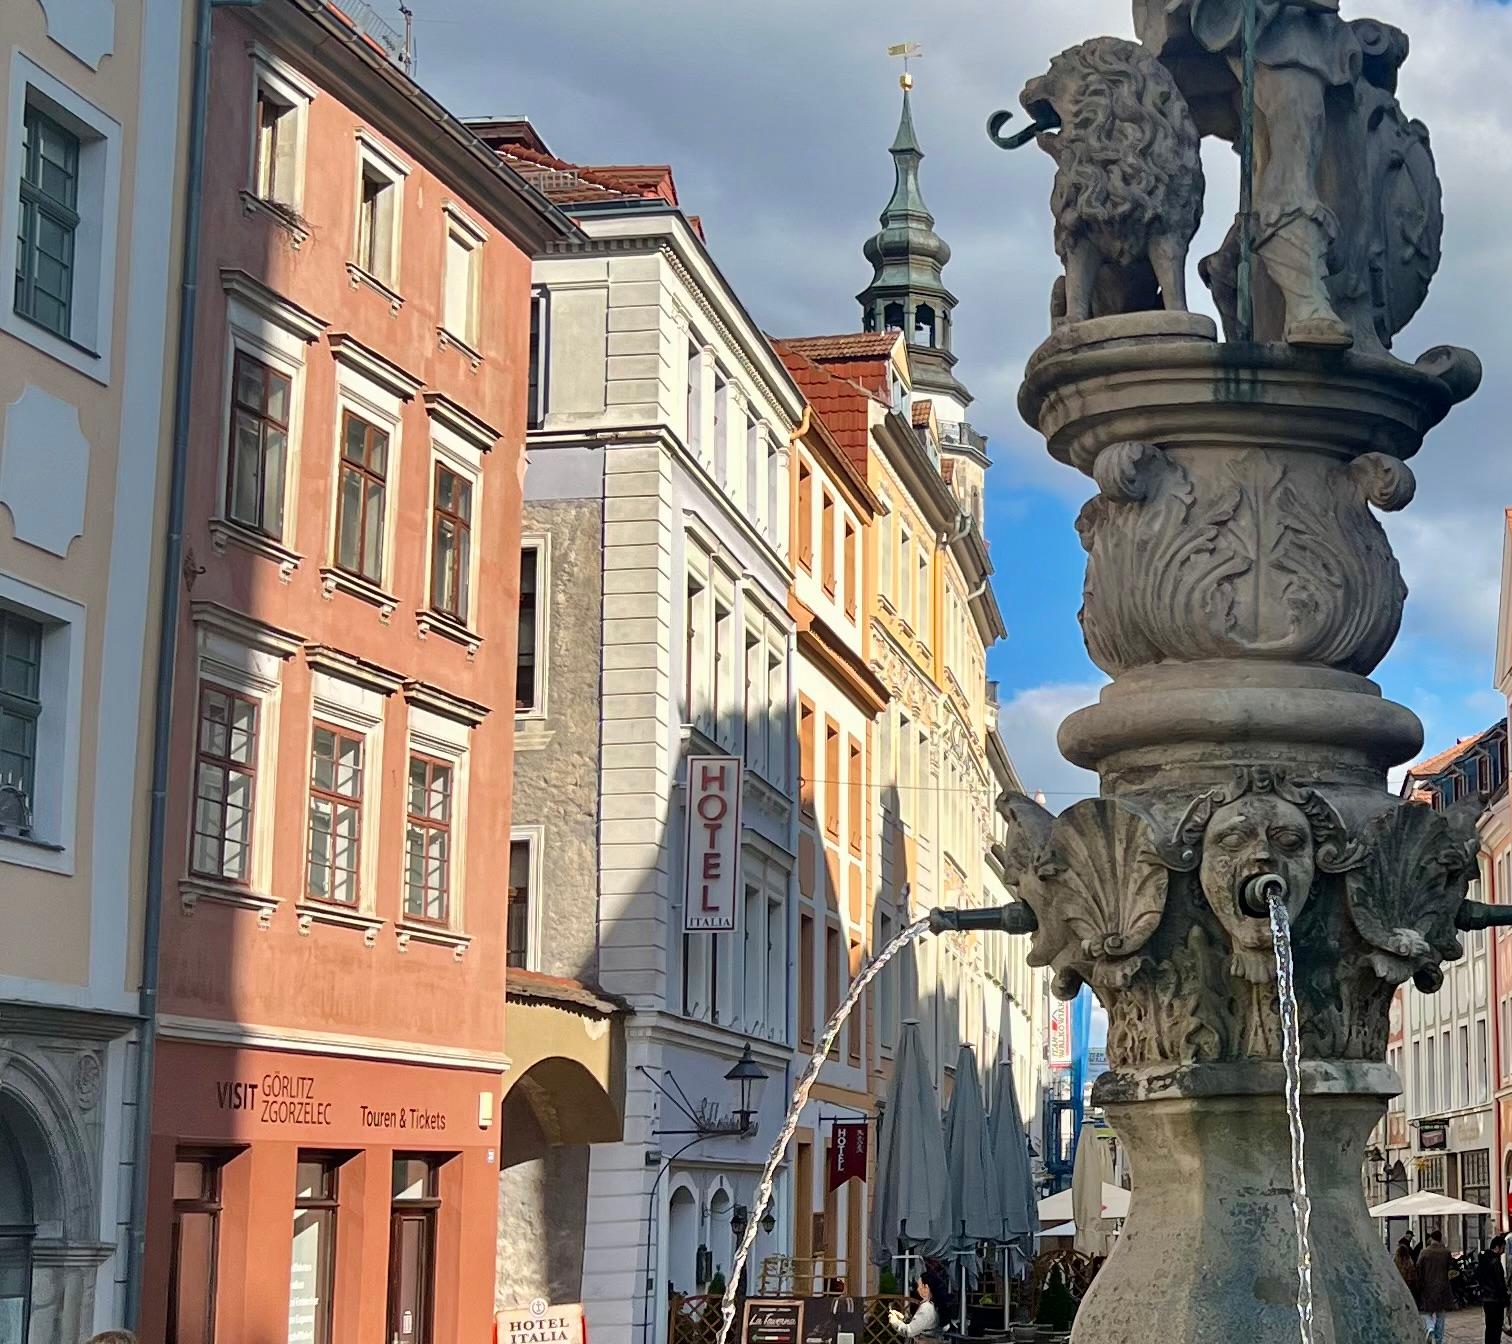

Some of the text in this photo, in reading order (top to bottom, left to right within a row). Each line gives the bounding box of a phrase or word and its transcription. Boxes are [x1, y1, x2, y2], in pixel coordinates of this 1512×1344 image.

[697, 765, 728, 913] HOTEL
[689, 916, 731, 928] ITALIA
[216, 1081, 258, 1110] VISIT
[262, 1070, 314, 1099] GÖRLITZ
[260, 1100, 332, 1125] ZGORZELEC
[360, 1105, 447, 1130] Touren & Tickets
[837, 1128, 847, 1171] HOTEL
[510, 1317, 570, 1332] HOTEL
[511, 1330, 569, 1344] ITALIA
